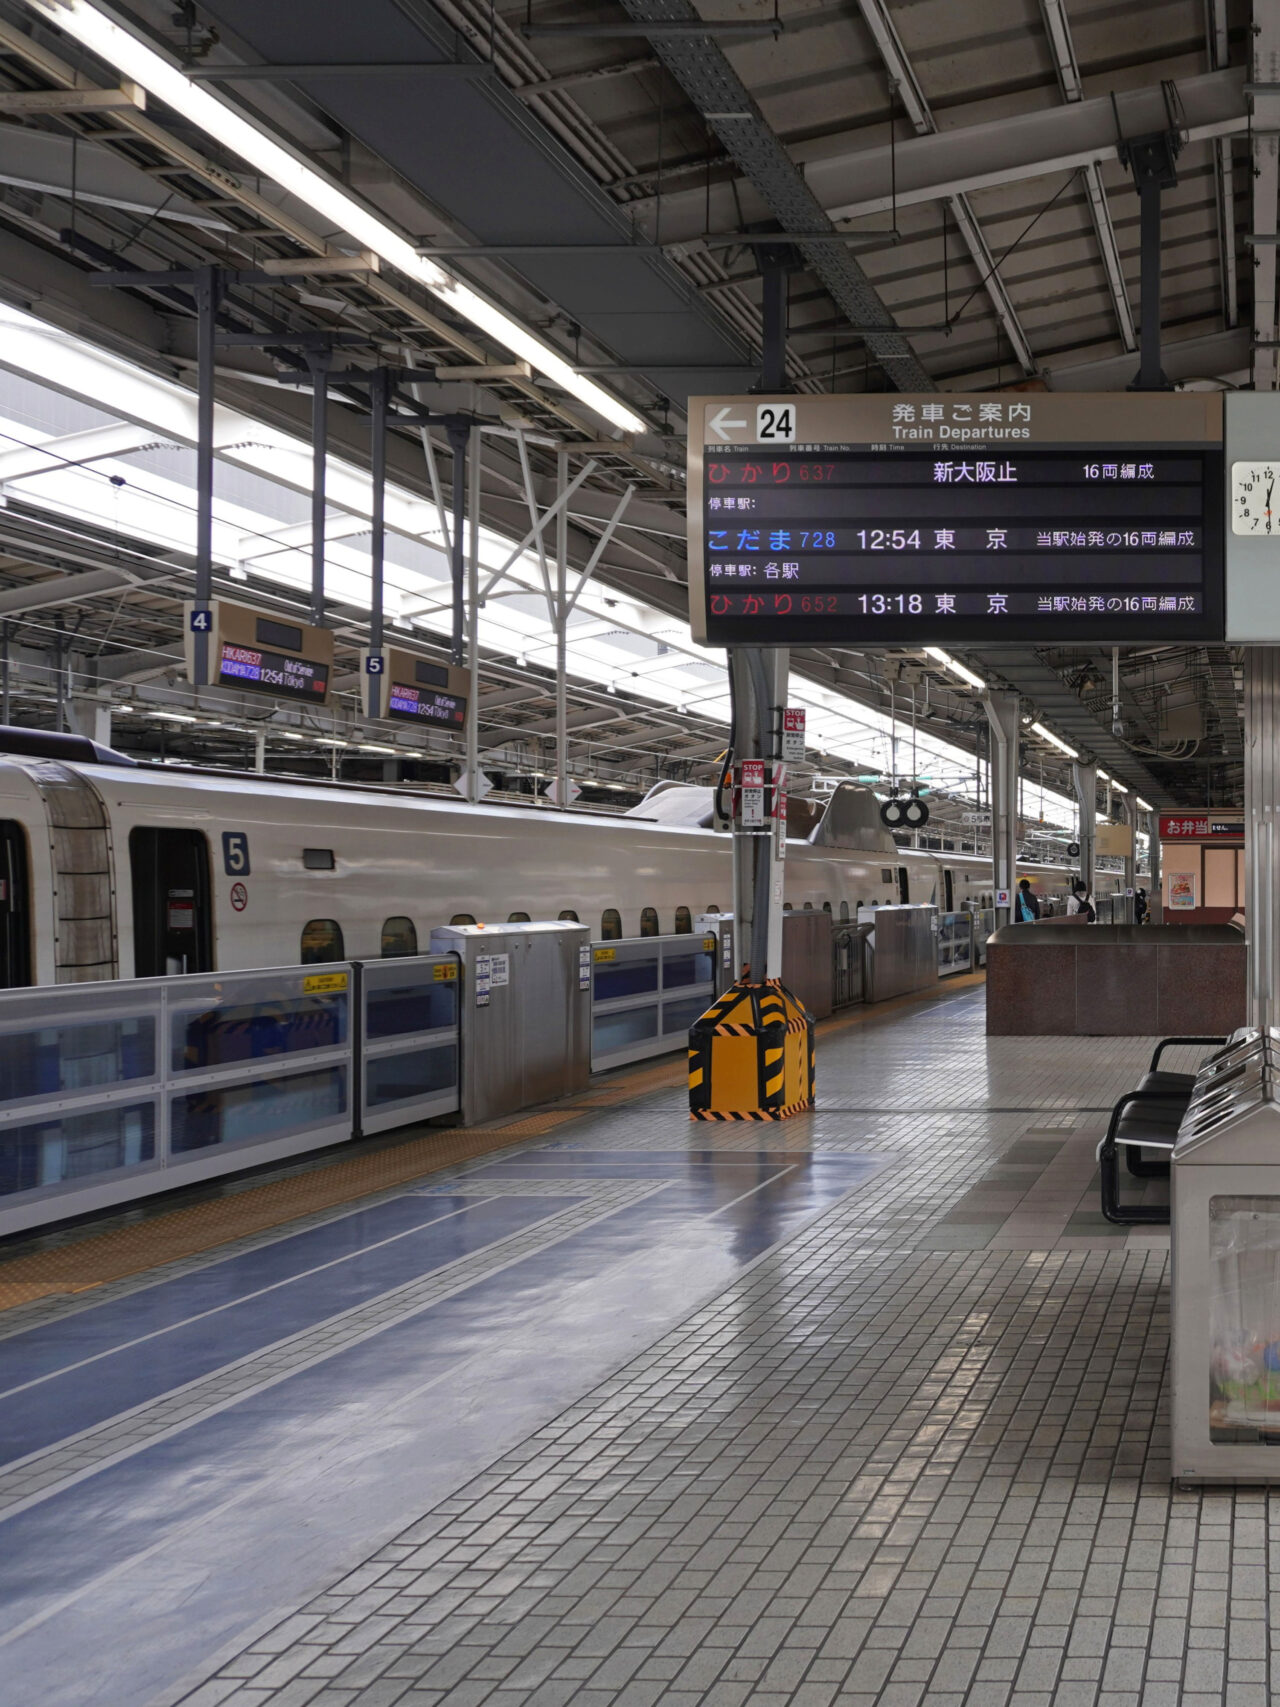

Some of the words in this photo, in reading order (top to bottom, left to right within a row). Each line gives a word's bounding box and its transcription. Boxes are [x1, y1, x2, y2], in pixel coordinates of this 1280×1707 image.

[893, 403, 1031, 423] 発車ご案内
[760, 409, 793, 439] 24
[892, 426, 933, 439] Train
[939, 426, 1030, 442] Departures
[708, 462, 791, 484] ひかり
[800, 465, 835, 481] 637
[933, 462, 1018, 483] 新大阪止
[1083, 463, 1155, 479] 16両編成
[708, 529, 792, 551] こだま
[800, 531, 836, 548] 728
[857, 530, 921, 550] 12:54
[1037, 531, 1195, 547] 当駅始発の16両編成
[763, 561, 799, 579] 各駅
[711, 594, 793, 615] ひかり
[801, 597, 838, 613] 652
[859, 595, 923, 615] 13:18
[1038, 596, 1196, 612] 当駅始発の16両編成
[193, 613, 207, 630] 4
[369, 657, 380, 672] 5
[1167, 820, 1208, 834] お弁当
[229, 837, 245, 871] 5
